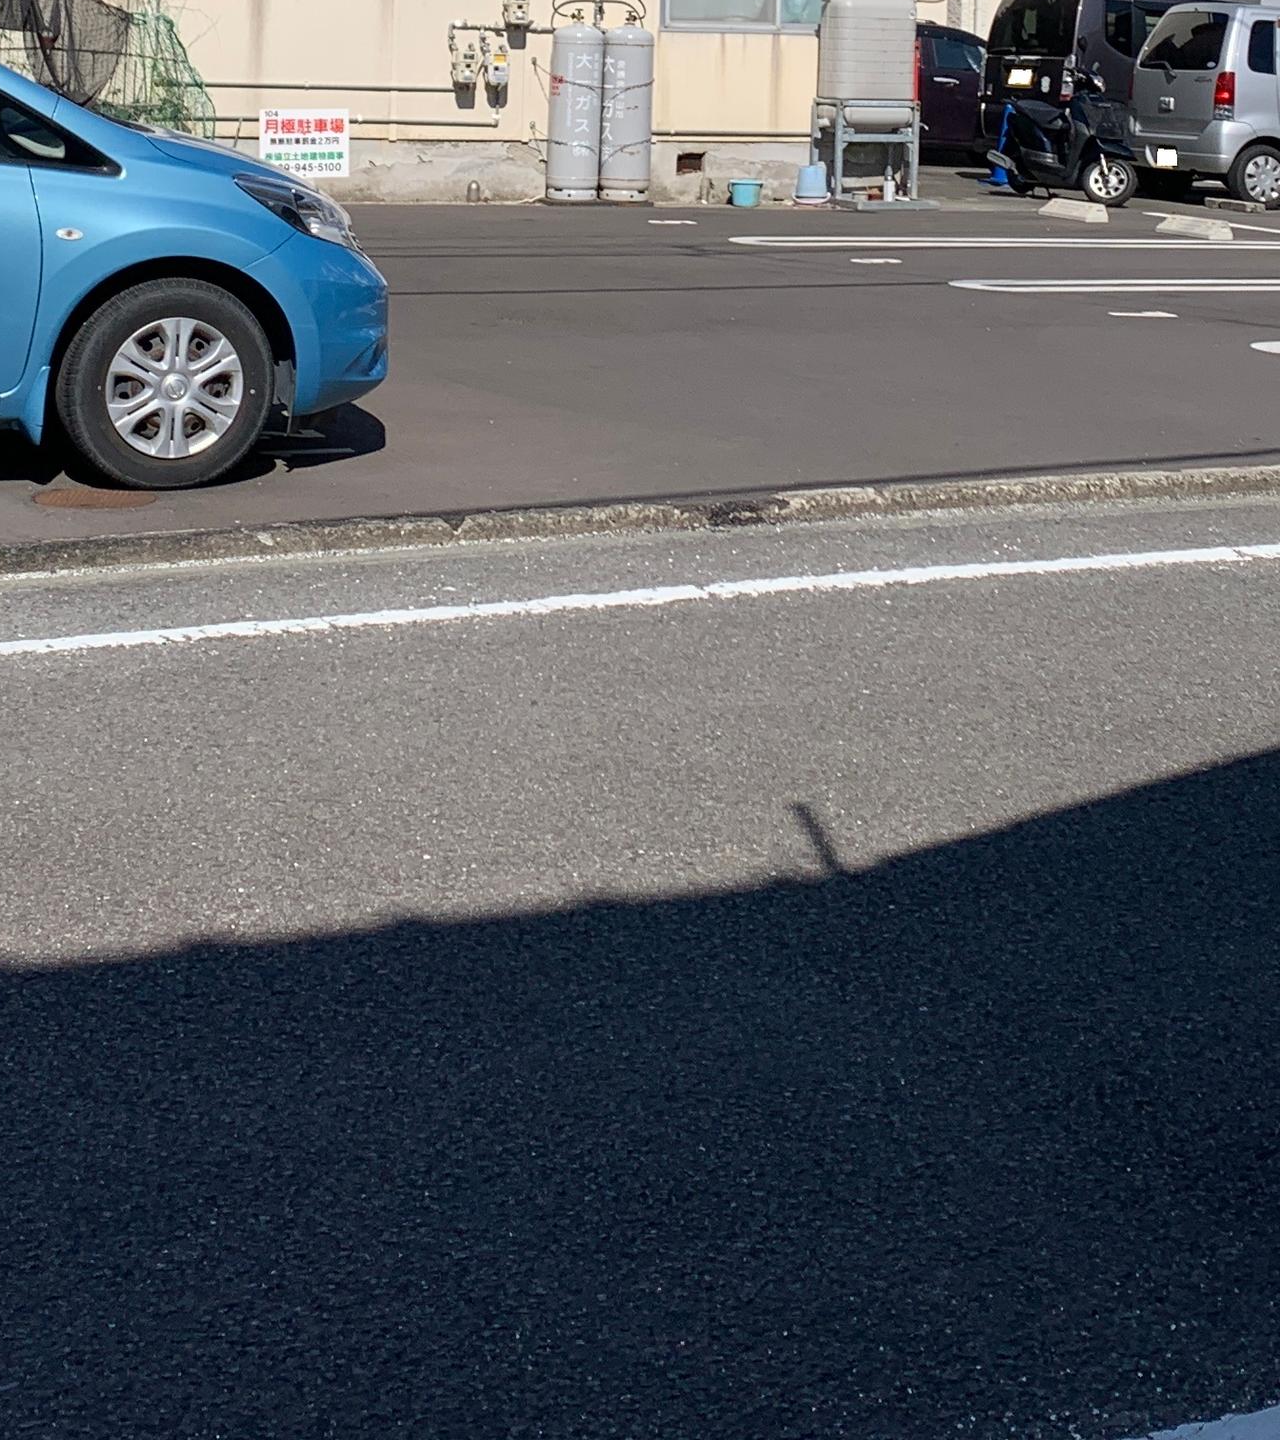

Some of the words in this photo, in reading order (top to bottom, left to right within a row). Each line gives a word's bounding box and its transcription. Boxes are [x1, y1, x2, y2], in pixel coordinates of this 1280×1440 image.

[264, 118, 344, 135] 月極駐車場
